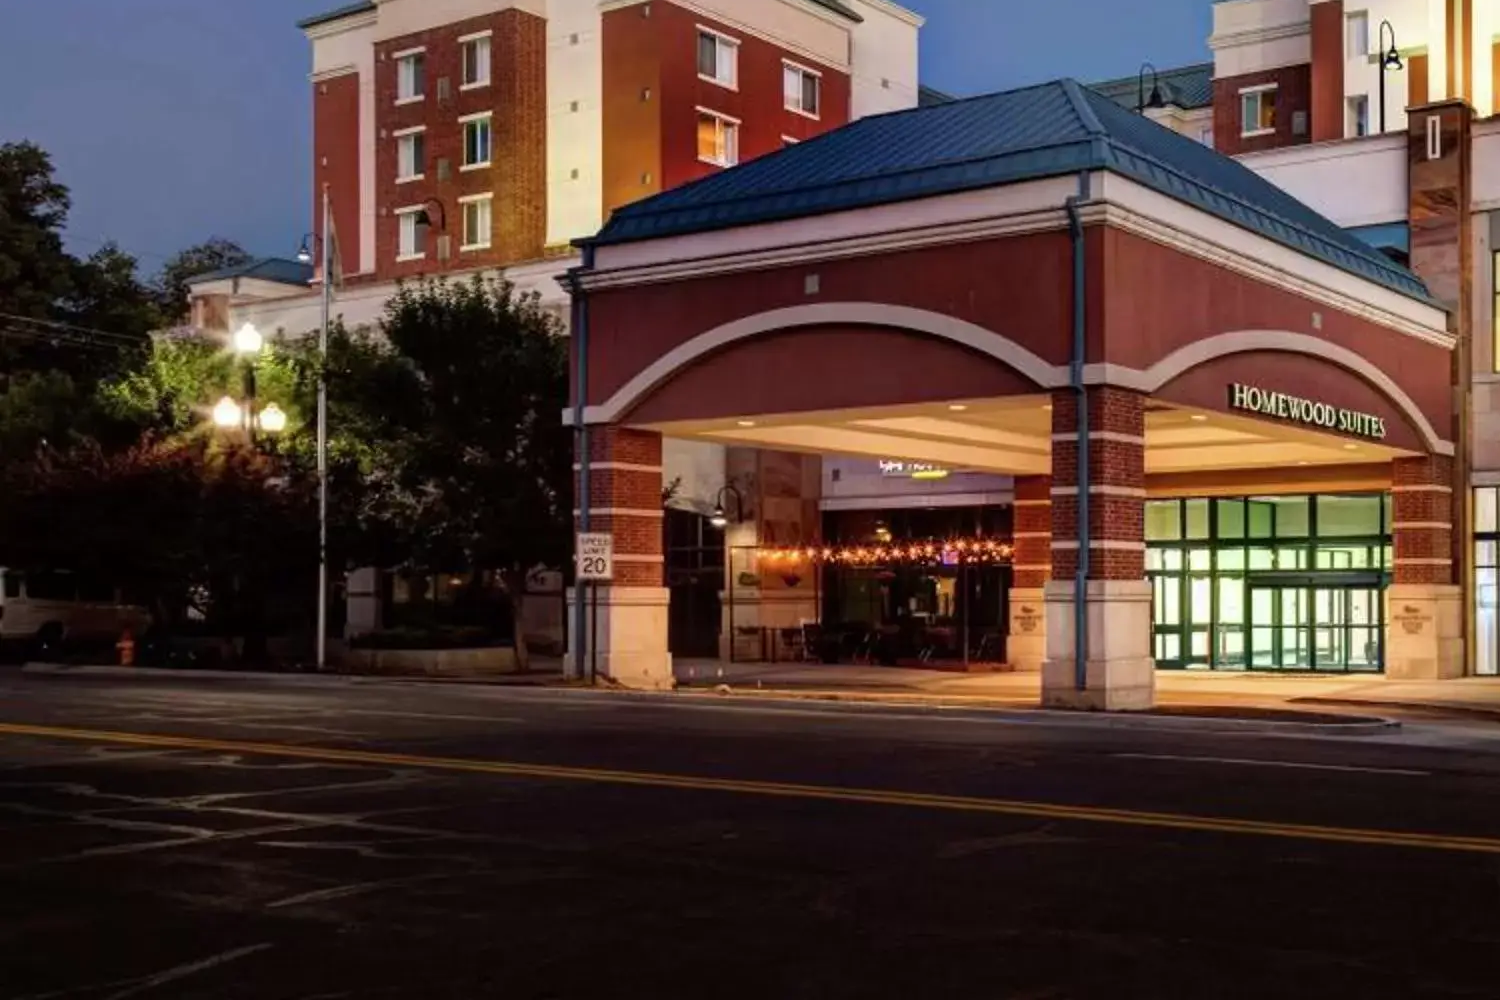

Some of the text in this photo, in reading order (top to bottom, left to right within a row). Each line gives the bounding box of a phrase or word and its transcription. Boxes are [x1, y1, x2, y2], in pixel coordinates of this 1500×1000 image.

[1233, 383, 1387, 439] HOMEWOOD SUITES
[583, 557, 606, 574] 20
